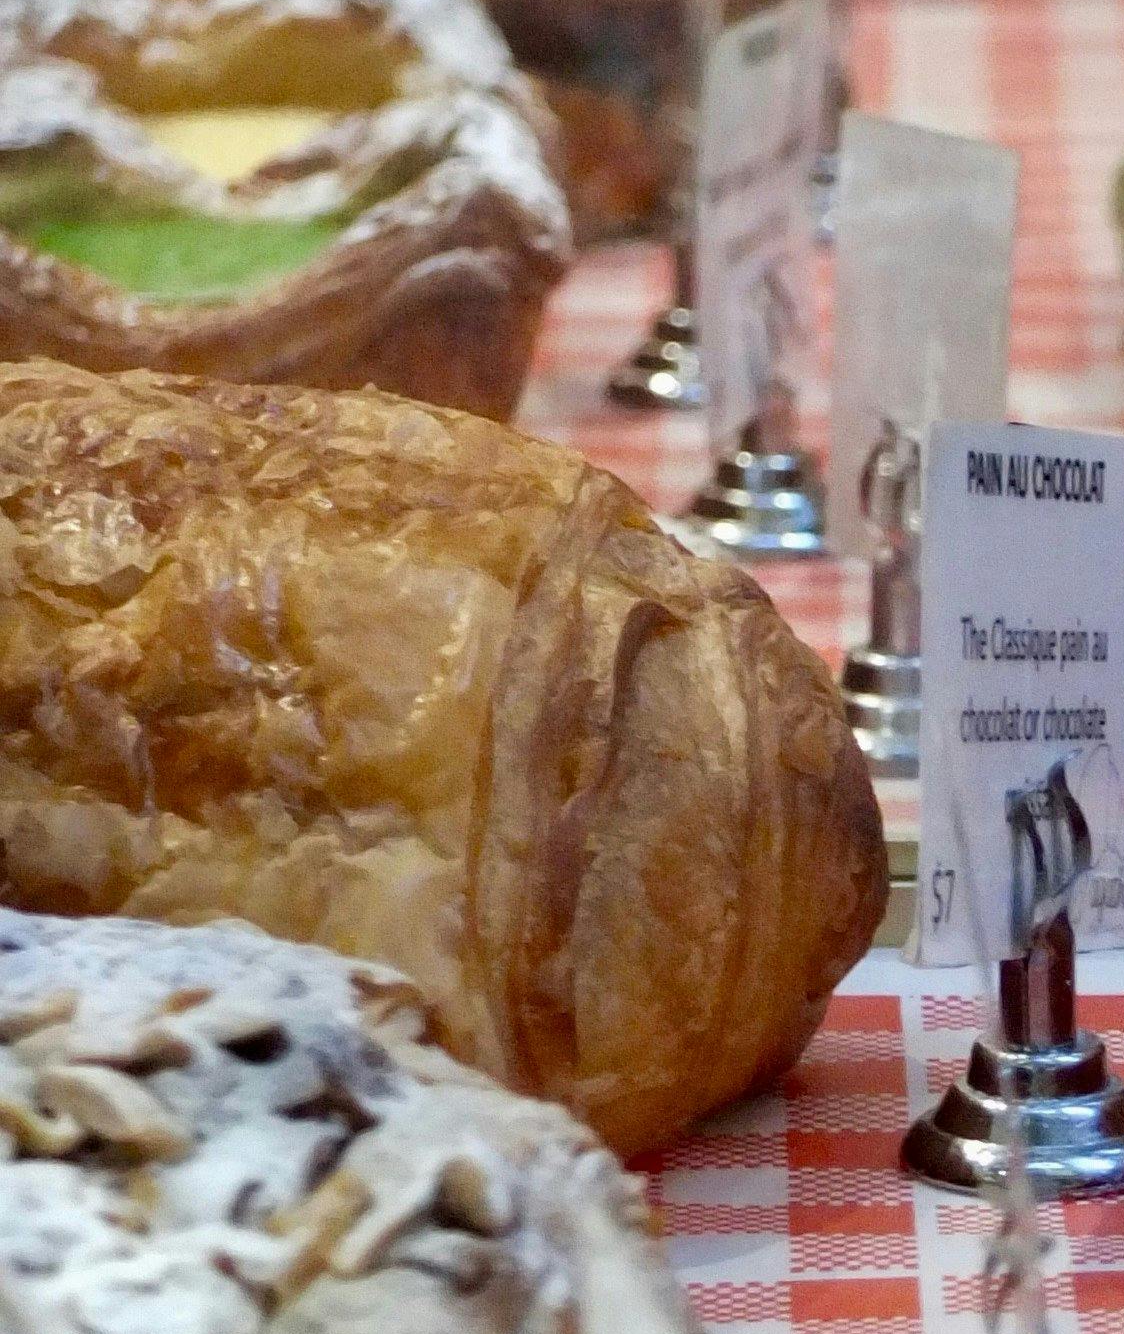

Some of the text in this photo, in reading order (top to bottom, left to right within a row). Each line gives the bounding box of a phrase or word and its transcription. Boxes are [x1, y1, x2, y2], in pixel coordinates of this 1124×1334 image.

[967, 450, 1105, 503] PAIN AU CHOCOLAT
[961, 616, 1108, 673] The Classique pain au
[960, 695, 1105, 742] chocolat or chocolate
[932, 861, 955, 934] $7
